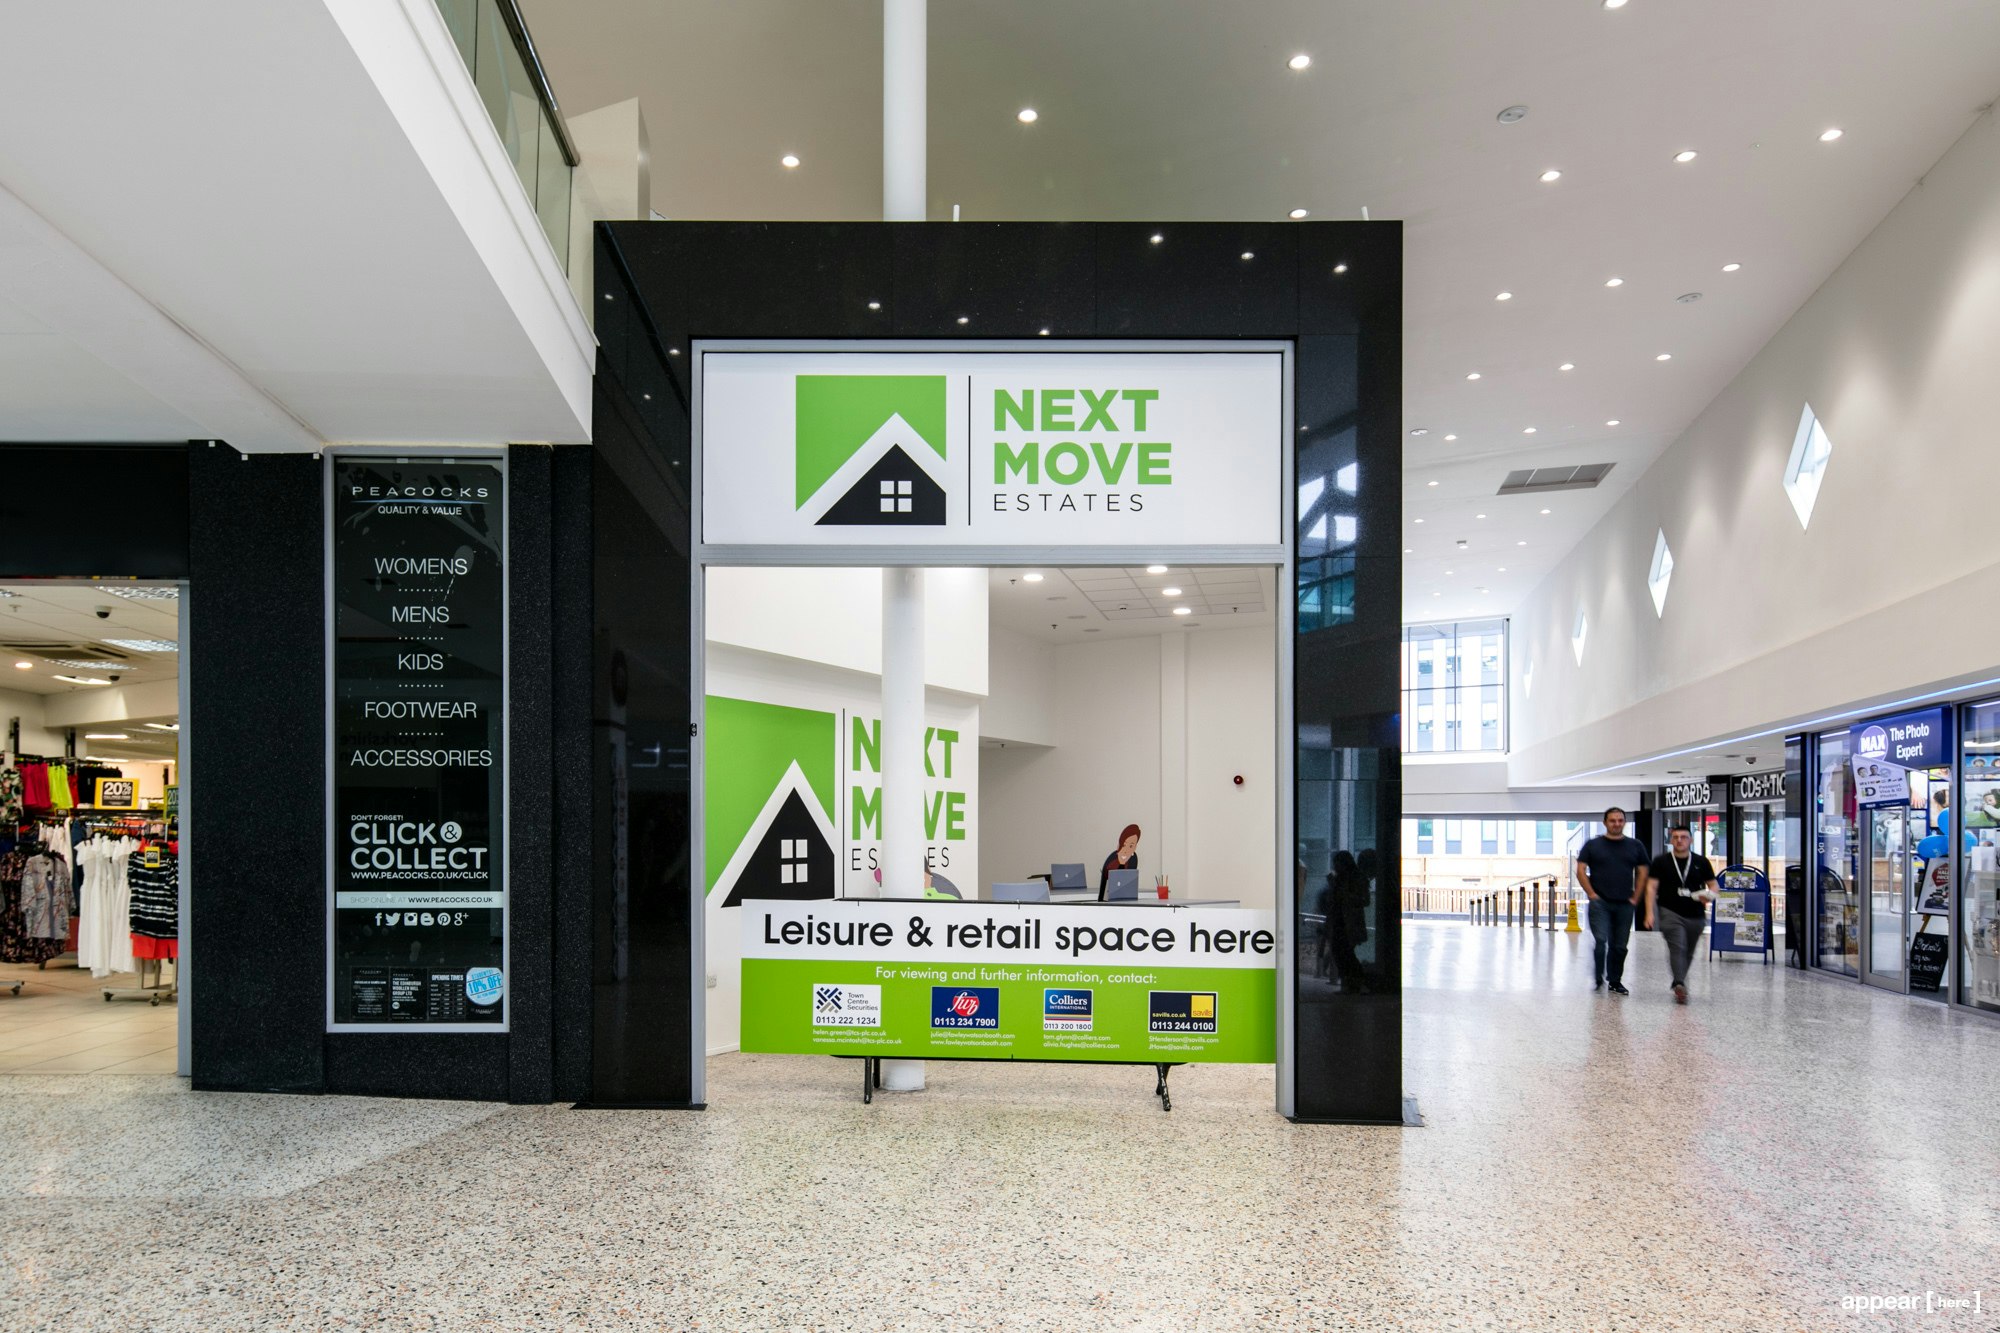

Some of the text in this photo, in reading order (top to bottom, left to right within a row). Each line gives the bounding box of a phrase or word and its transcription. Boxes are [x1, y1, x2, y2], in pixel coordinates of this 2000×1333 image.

[994, 389, 1159, 432] NEXT
[994, 442, 1172, 486] MOVE
[352, 486, 489, 498] PEACOCKS
[378, 506, 462, 516] QUALITY & VALUE
[994, 494, 1144, 513] ESTATES
[375, 558, 468, 576] WOMENS
[392, 606, 450, 623] MENS
[399, 654, 444, 670] KIDS
[365, 702, 477, 718] FOOTWEAR
[1890, 722, 1930, 741] The Photo
[852, 716, 960, 779] NXT
[1860, 734, 1886, 752] MAX
[1896, 742, 1924, 761] Expert
[351, 750, 492, 767] ACCESSORIES
[1666, 783, 1711, 806] RECORDS
[852, 786, 966, 841] MVE
[350, 822, 437, 844] CLICK
[350, 847, 488, 870] COLLECT
[852, 847, 950, 871] ESES
[351, 872, 488, 880] WWW.PEACOCKS.CO.UK/CLICK
[408, 896, 494, 904] WWW.PEACOCKS.CO.UK
[764, 914, 1275, 958] Leisure & retail space here
[876, 966, 1158, 985] For viewing and further information, contact:
[468, 980, 487, 994] 10%
[1049, 994, 1088, 1006] Colliers
[816, 1016, 876, 1025] 0113 222 1234
[1192, 1009, 1213, 1017] savills
[934, 1018, 996, 1027] 0113 234 7900
[1152, 1022, 1214, 1031] 0113 244 0100
